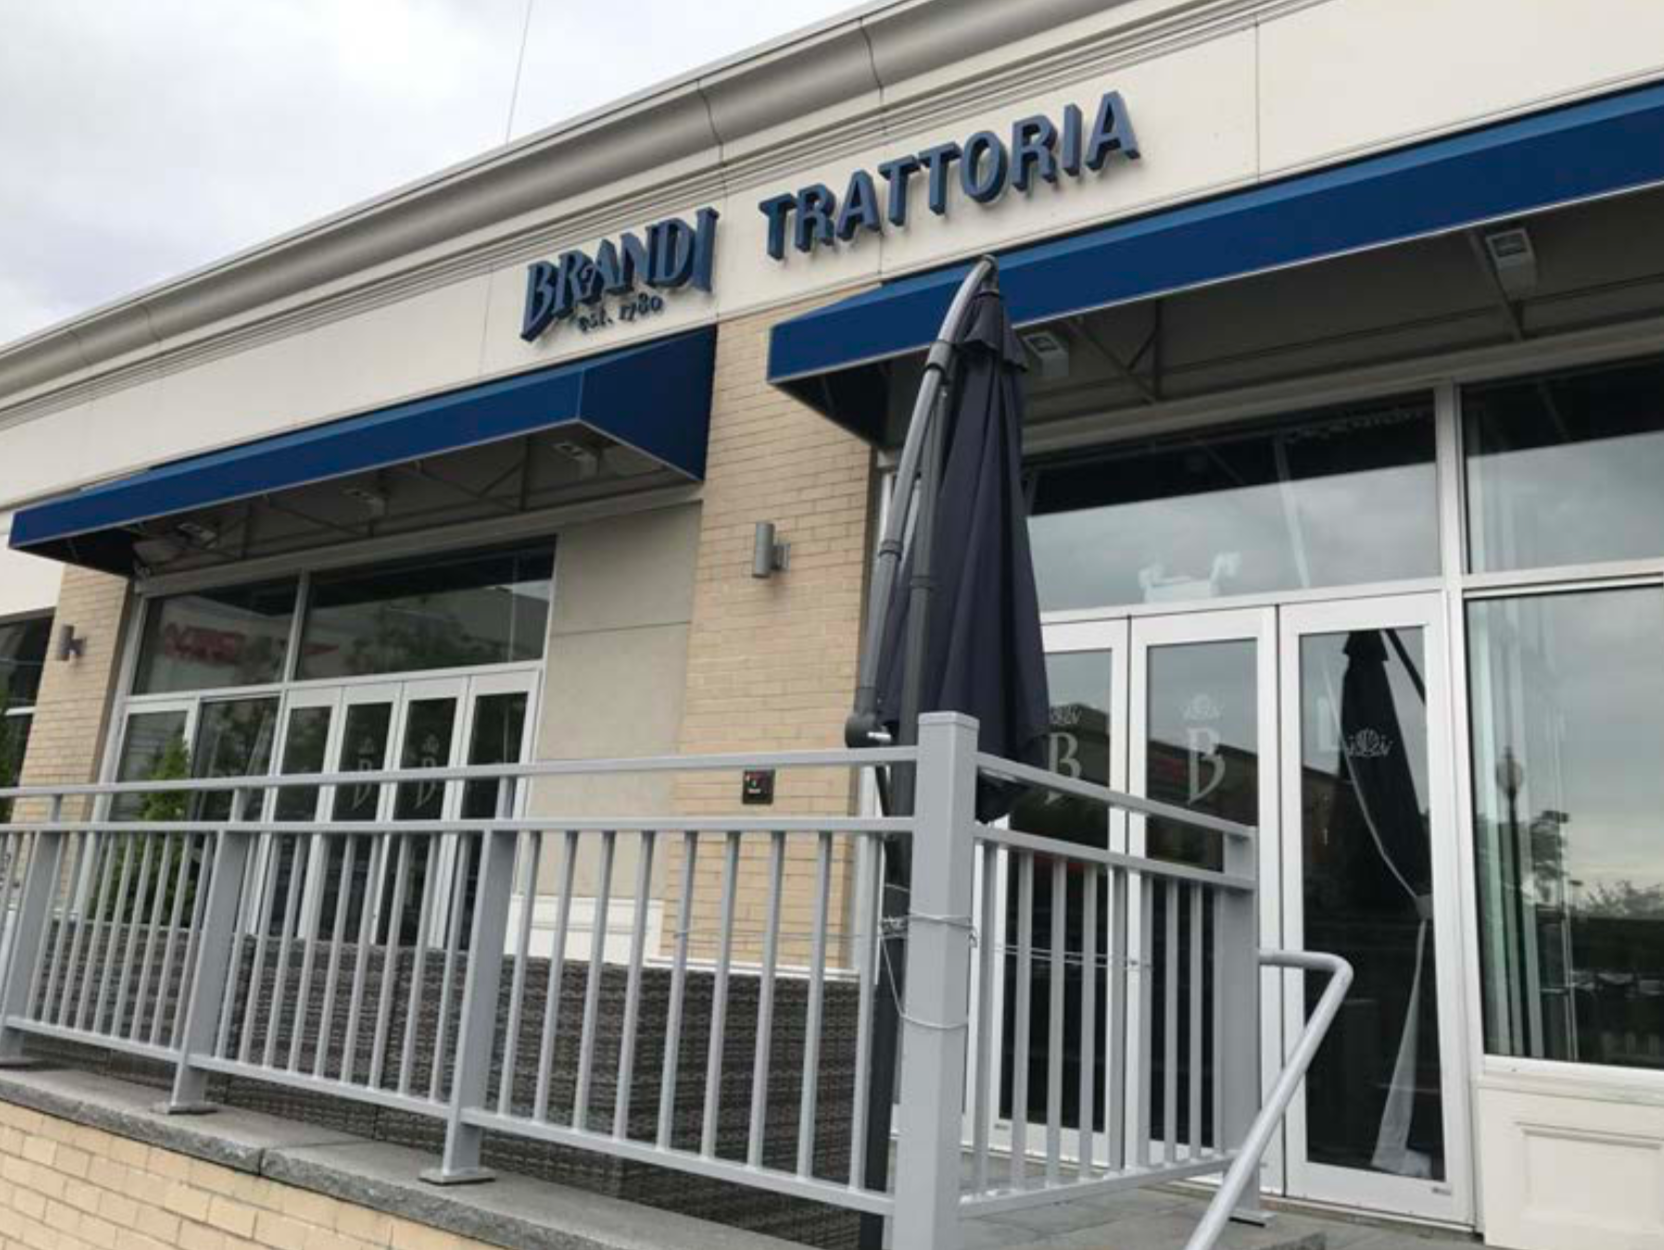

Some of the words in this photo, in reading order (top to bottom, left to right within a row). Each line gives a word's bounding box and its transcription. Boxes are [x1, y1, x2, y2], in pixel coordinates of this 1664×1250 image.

[521, 207, 719, 342] BRANDI
[758, 90, 1141, 261] TRATTORIA
[619, 292, 664, 321] 1780
[1045, 731, 1082, 805] B
[1187, 727, 1226, 805] B
